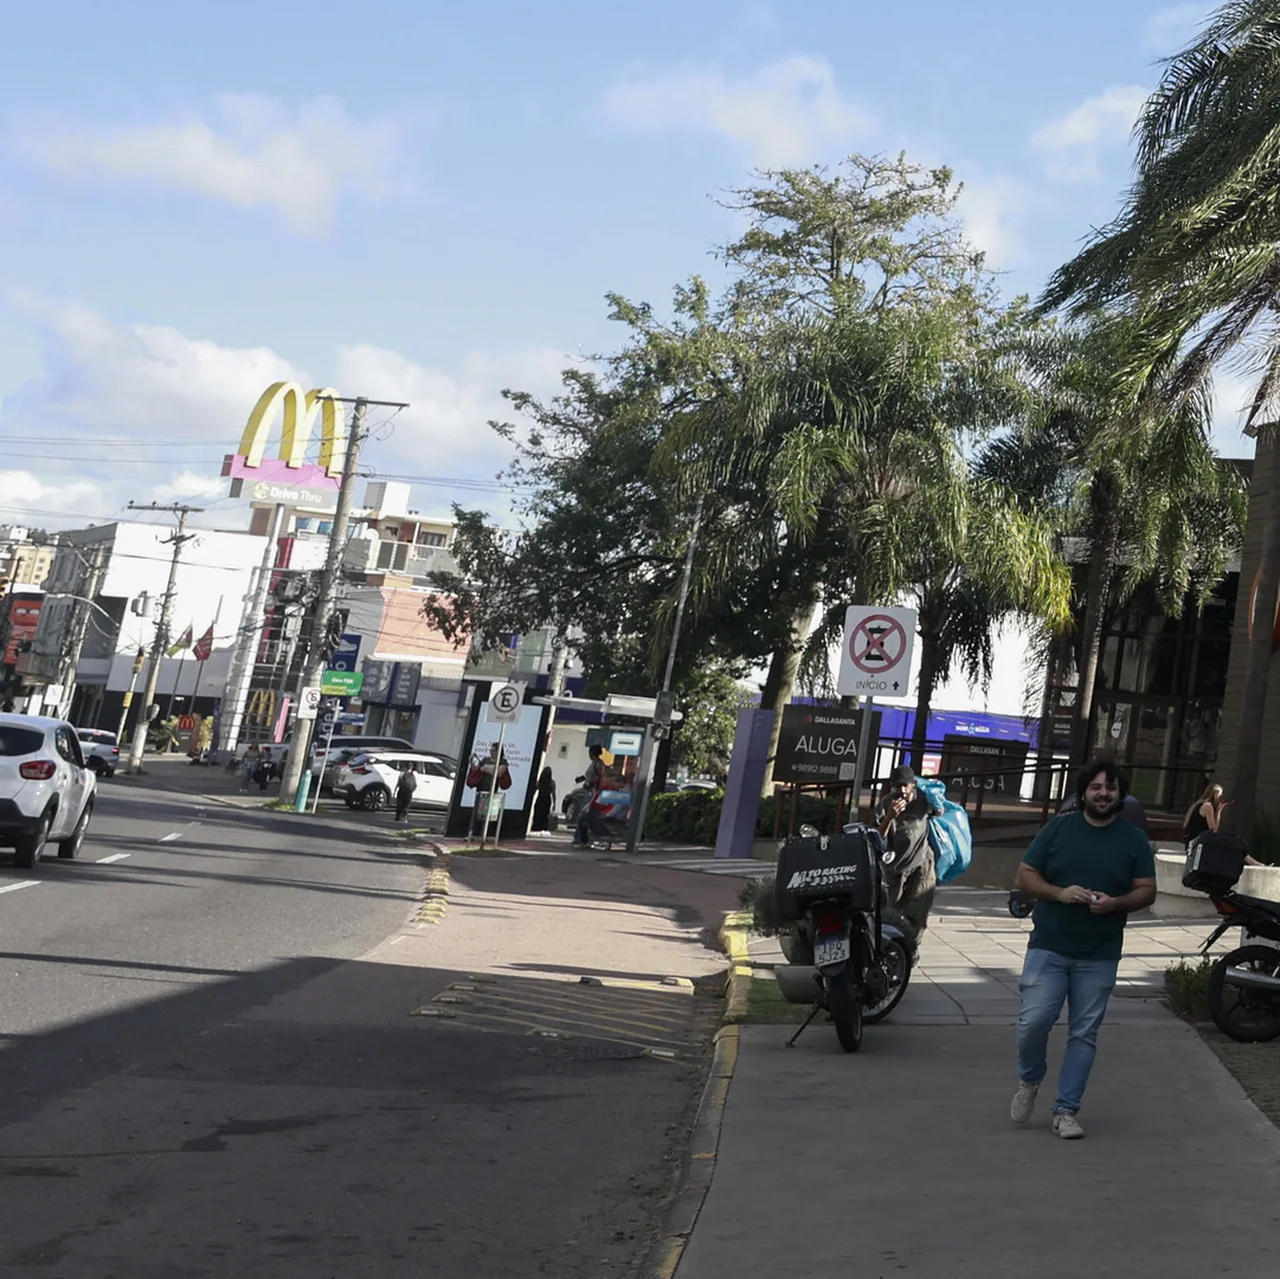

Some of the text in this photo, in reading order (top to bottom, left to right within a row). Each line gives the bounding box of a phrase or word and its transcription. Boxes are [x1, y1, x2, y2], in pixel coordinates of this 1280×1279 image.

[270, 487, 322, 503] Drive Thru
[814, 716, 856, 726] DALLASANTA
[795, 735, 857, 757] ALUGA
[822, 864, 858, 876] RACING
